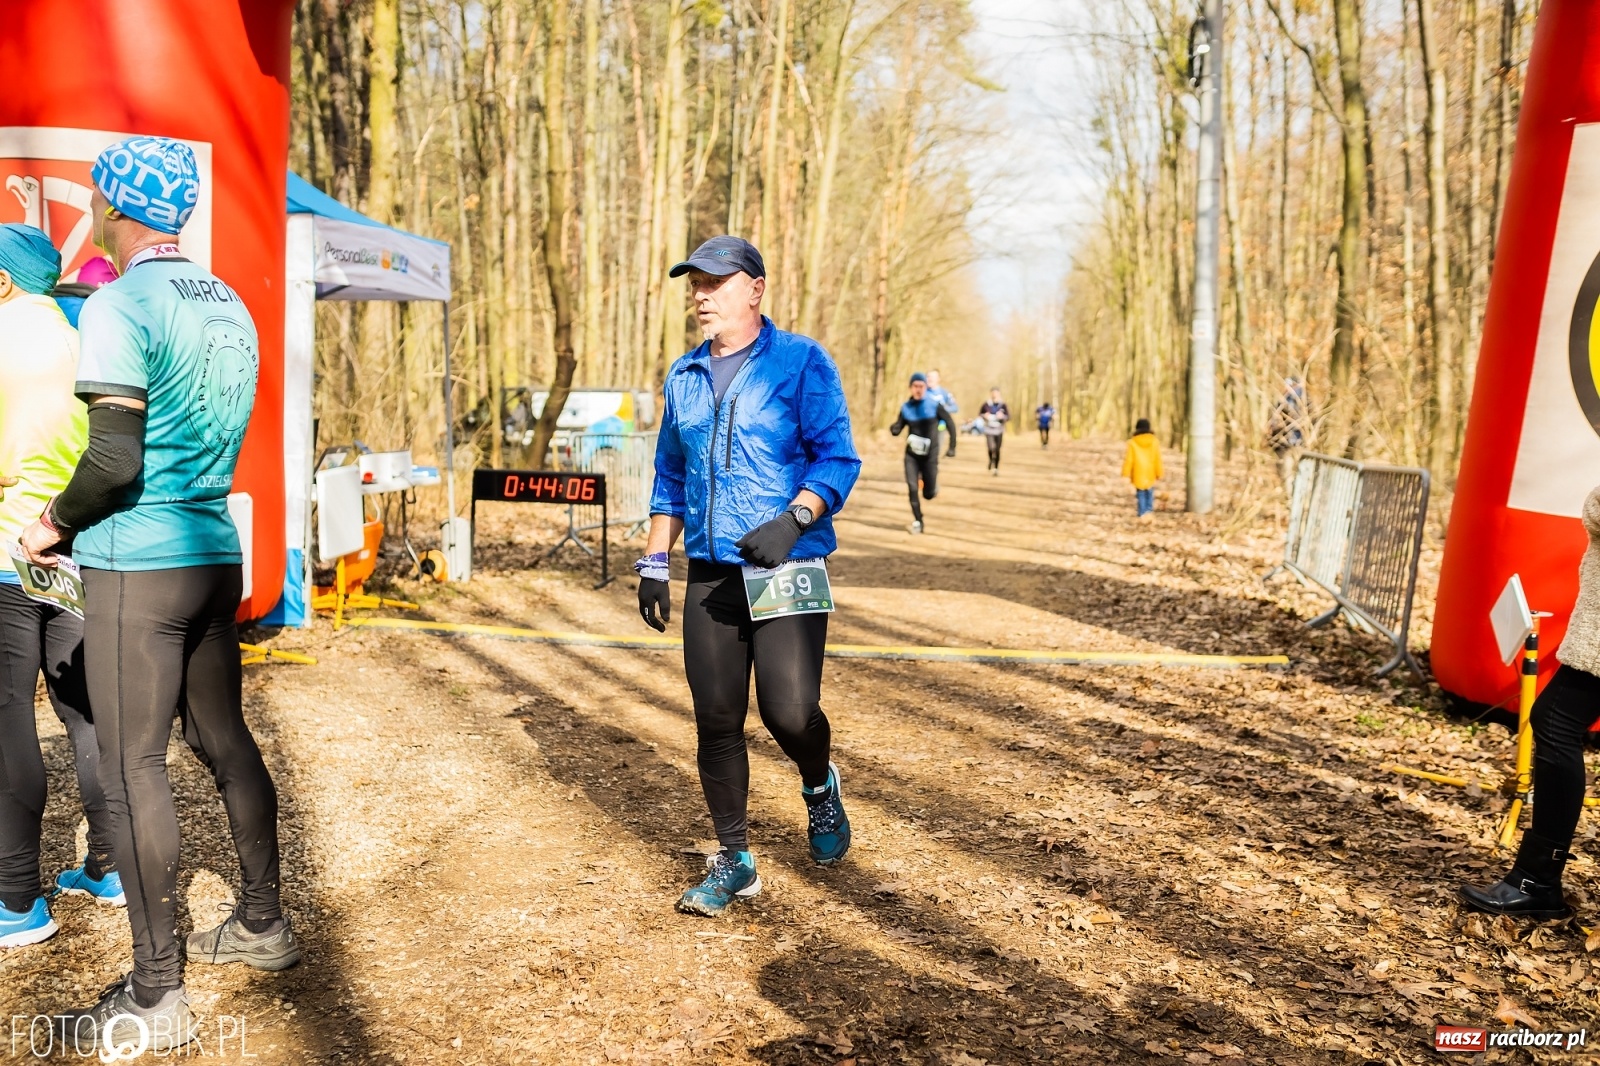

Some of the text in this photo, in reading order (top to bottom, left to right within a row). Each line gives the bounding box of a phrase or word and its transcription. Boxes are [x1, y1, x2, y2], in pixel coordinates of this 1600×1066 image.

[504, 475, 596, 501] 0:44:06
[30, 565, 78, 601] 006
[765, 573, 812, 600] 159
